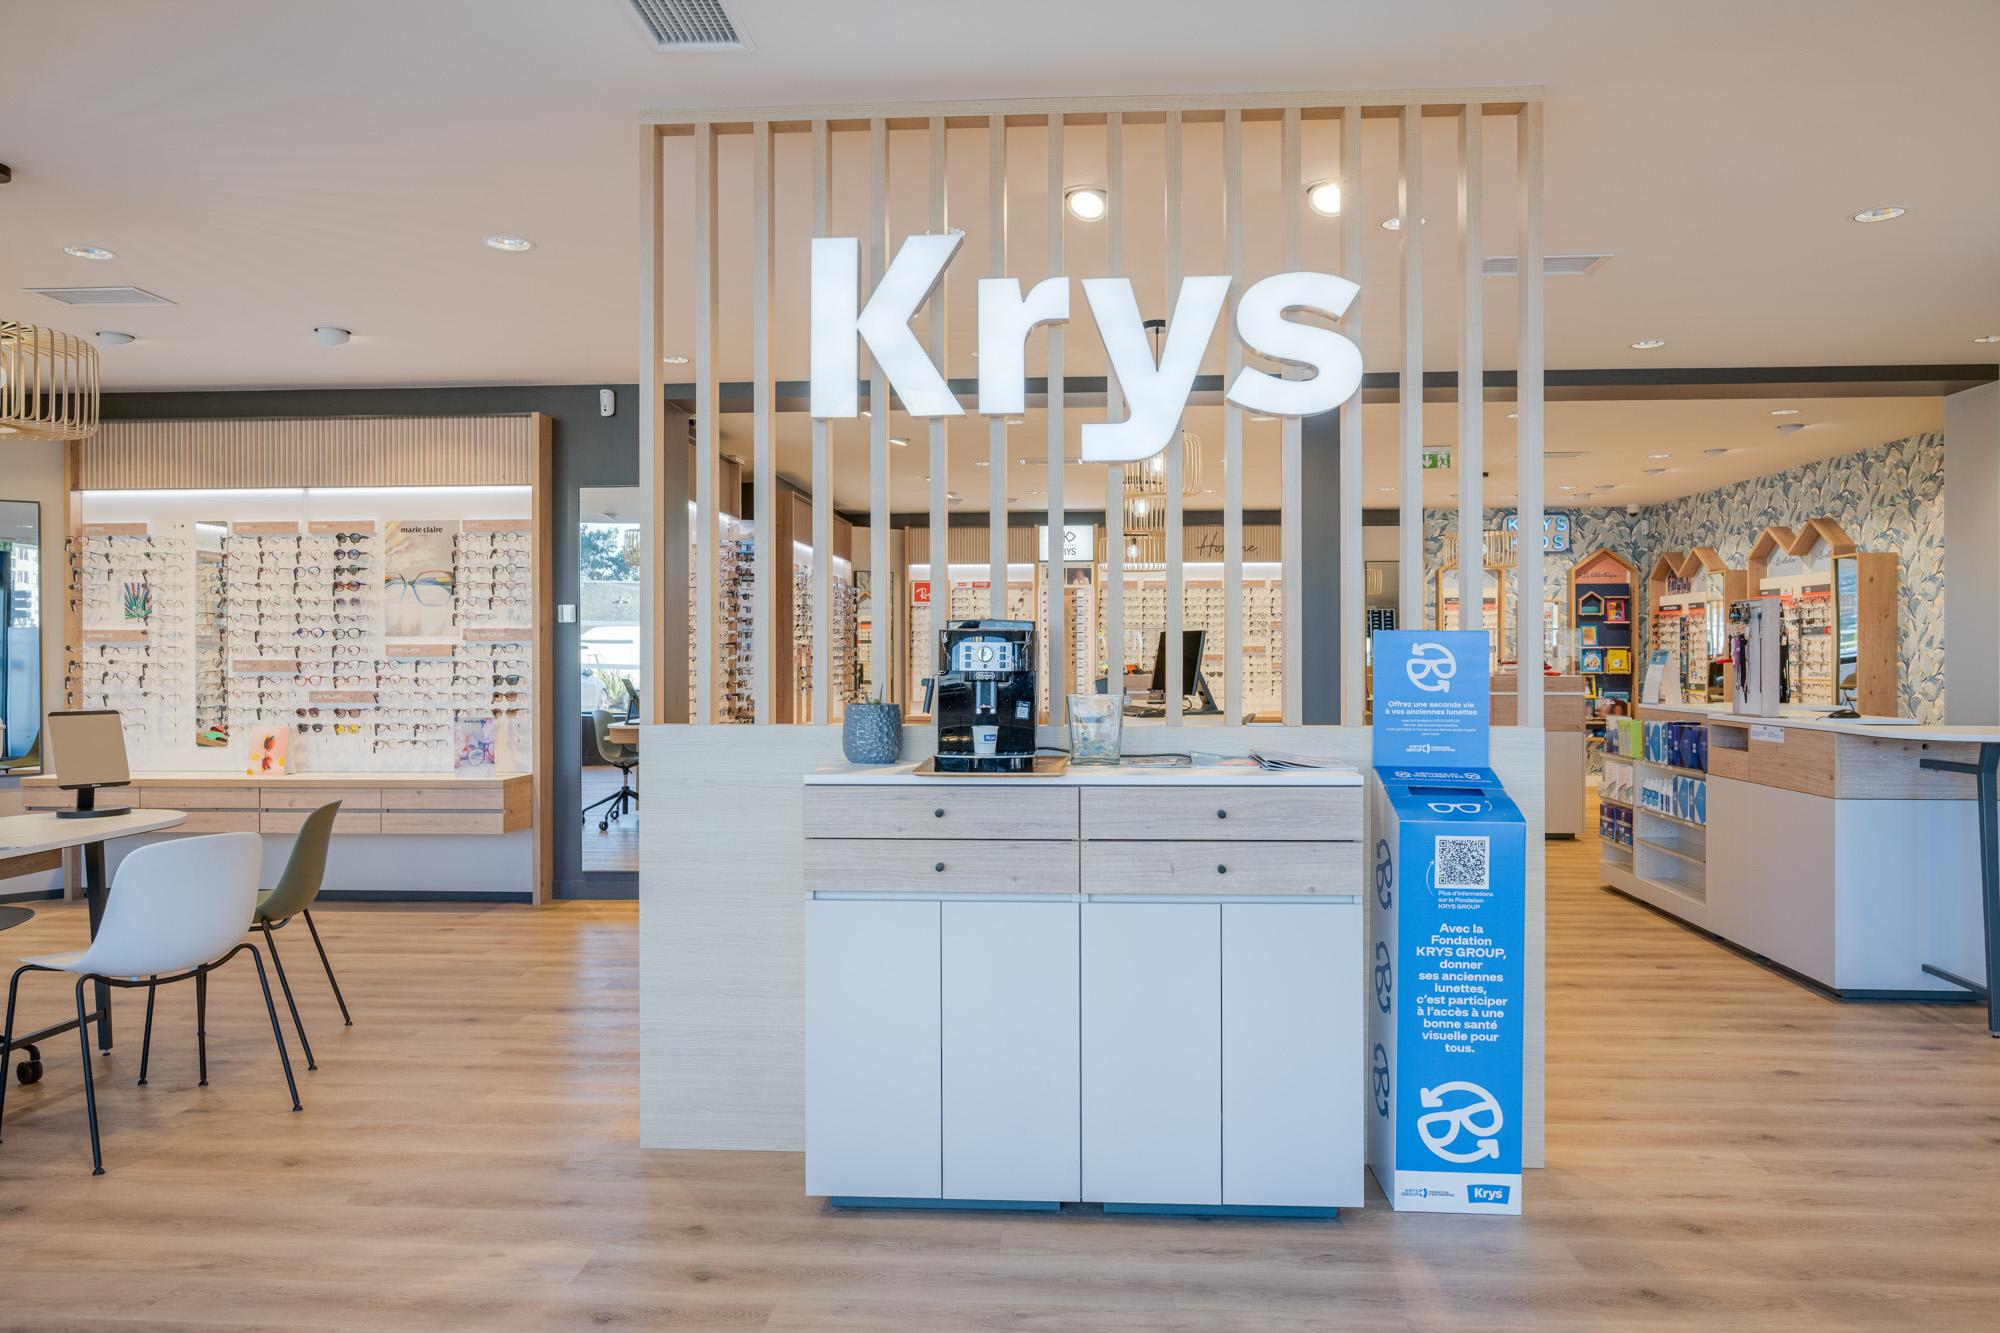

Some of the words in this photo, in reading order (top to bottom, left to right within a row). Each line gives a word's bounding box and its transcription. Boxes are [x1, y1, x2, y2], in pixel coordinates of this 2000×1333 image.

[810, 233, 1364, 463] Krys
[1507, 517, 1566, 531] KYS
[1195, 531, 1258, 558] Hoe
[1440, 923, 1470, 934] Avec
[1472, 924, 1484, 934] la
[1431, 935, 1492, 946] Fondation
[1416, 946, 1453, 957] KRYS
[1455, 948, 1507, 960] GROUP,
[1440, 959, 1483, 970] donner
[1418, 972, 1439, 981] ses
[1441, 971, 1504, 983] anciennes
[1434, 983, 1487, 995] lunettes,
[1416, 994, 1446, 1005] c'est
[1448, 995, 1508, 1008] participer
[1417, 1006, 1424, 1016] à
[1427, 1006, 1469, 1017] l'accès
[1471, 1007, 1479, 1017] à
[1481, 1009, 1505, 1018] une
[1423, 1018, 1461, 1029] bonne
[1463, 1019, 1498, 1029] santé
[1421, 1029, 1468, 1041] visuelle
[1470, 1032, 1499, 1043] pour
[1445, 1043, 1476, 1053] tous.
[1474, 1188, 1503, 1201] Krys
